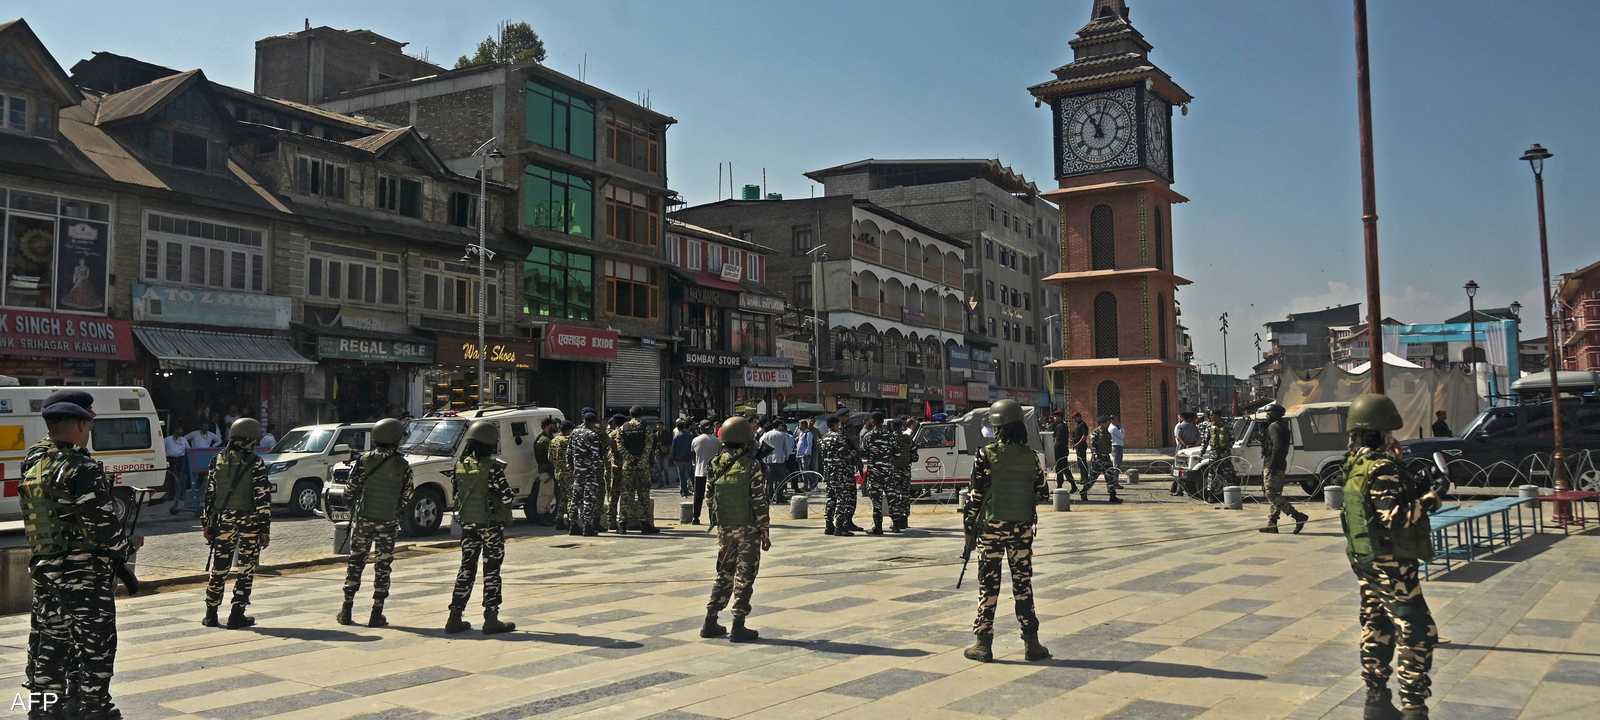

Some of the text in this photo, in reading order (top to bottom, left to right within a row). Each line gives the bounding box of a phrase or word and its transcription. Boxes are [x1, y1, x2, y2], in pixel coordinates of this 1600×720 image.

[167, 290, 194, 303] TO
[15, 316, 61, 336] SINGH
[65, 320, 76, 336] &
[79, 321, 115, 340] SONS
[340, 338, 426, 356] REGAL SALE
[591, 337, 614, 349] EXIDE
[490, 344, 516, 362] Shoes
[686, 353, 716, 364] BOMBAY
[718, 355, 741, 366] STORE
[752, 370, 777, 383] EXIDE
[499, 384, 505, 393] P
[113, 464, 150, 472] SUPPORT
